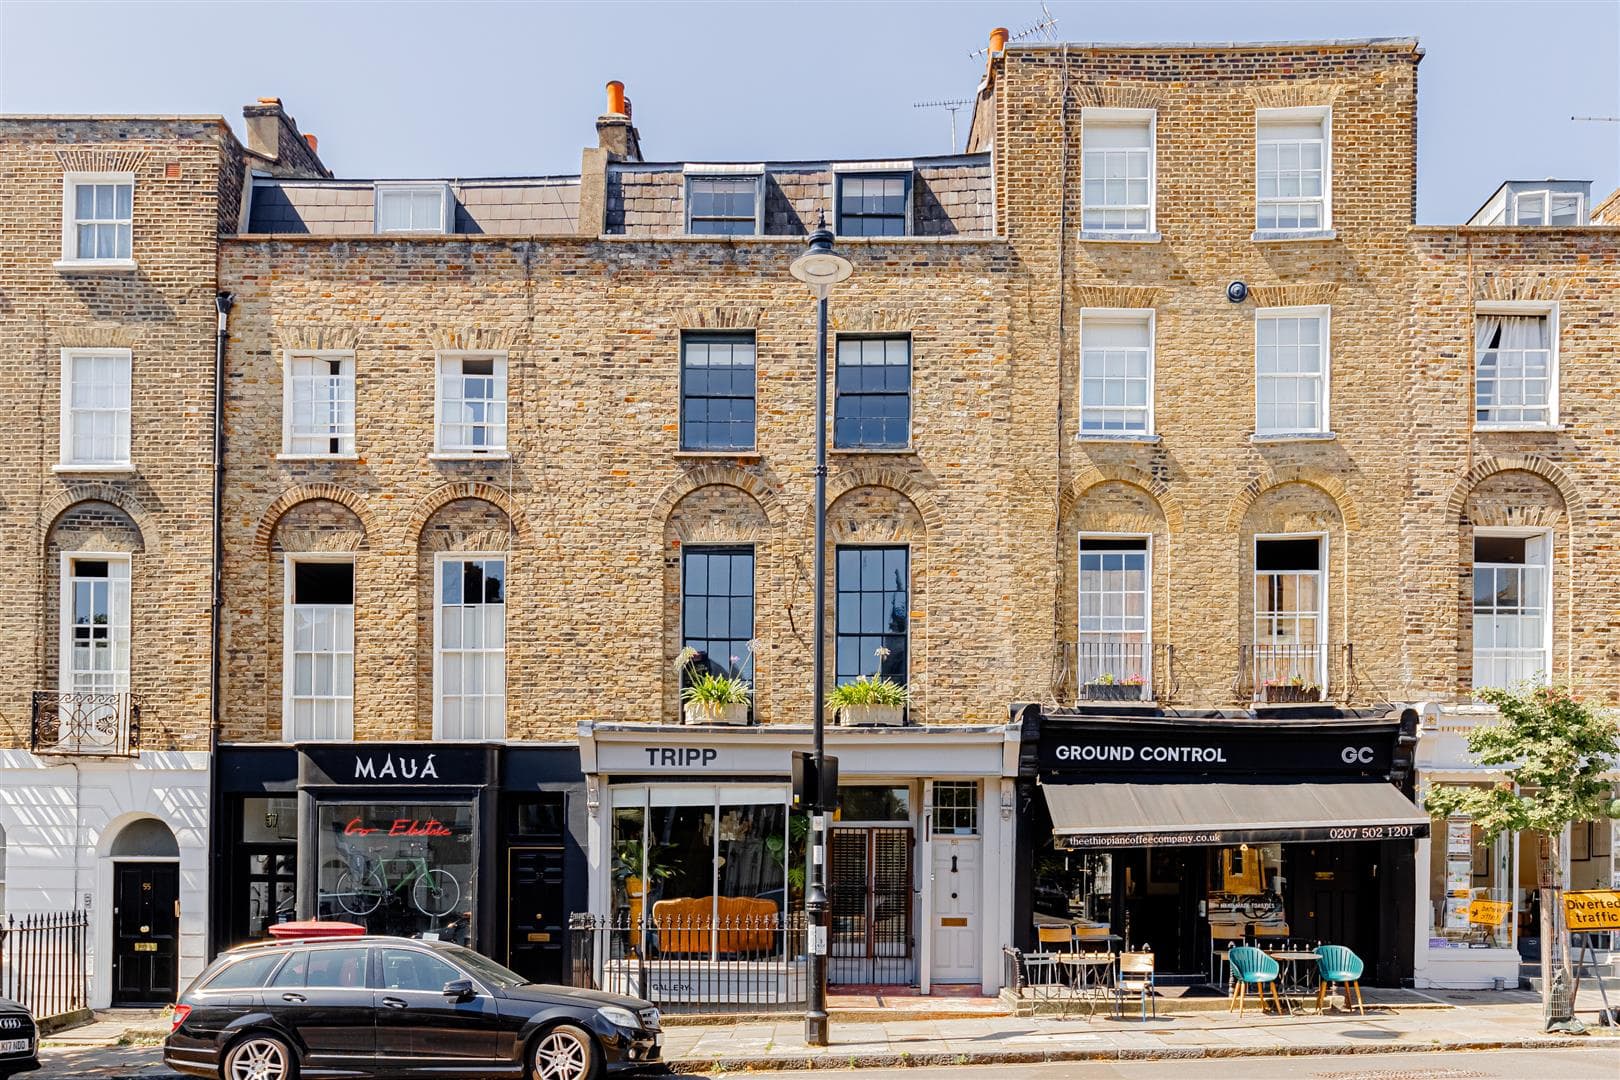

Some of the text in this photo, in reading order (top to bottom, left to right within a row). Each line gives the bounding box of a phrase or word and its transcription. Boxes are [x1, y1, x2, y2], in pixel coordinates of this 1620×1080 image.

[645, 748, 717, 766] TRIPP
[1056, 745, 1227, 763] GROUND CONTROL
[1341, 746, 1374, 764] GC
[354, 752, 439, 779] MAUÁ
[343, 816, 380, 837] Go
[1329, 826, 1414, 839] 0207 502 1201
[1069, 832, 1221, 846] theethiopiancoffeecompany.co.uk
[1576, 912, 1618, 923] traffic
